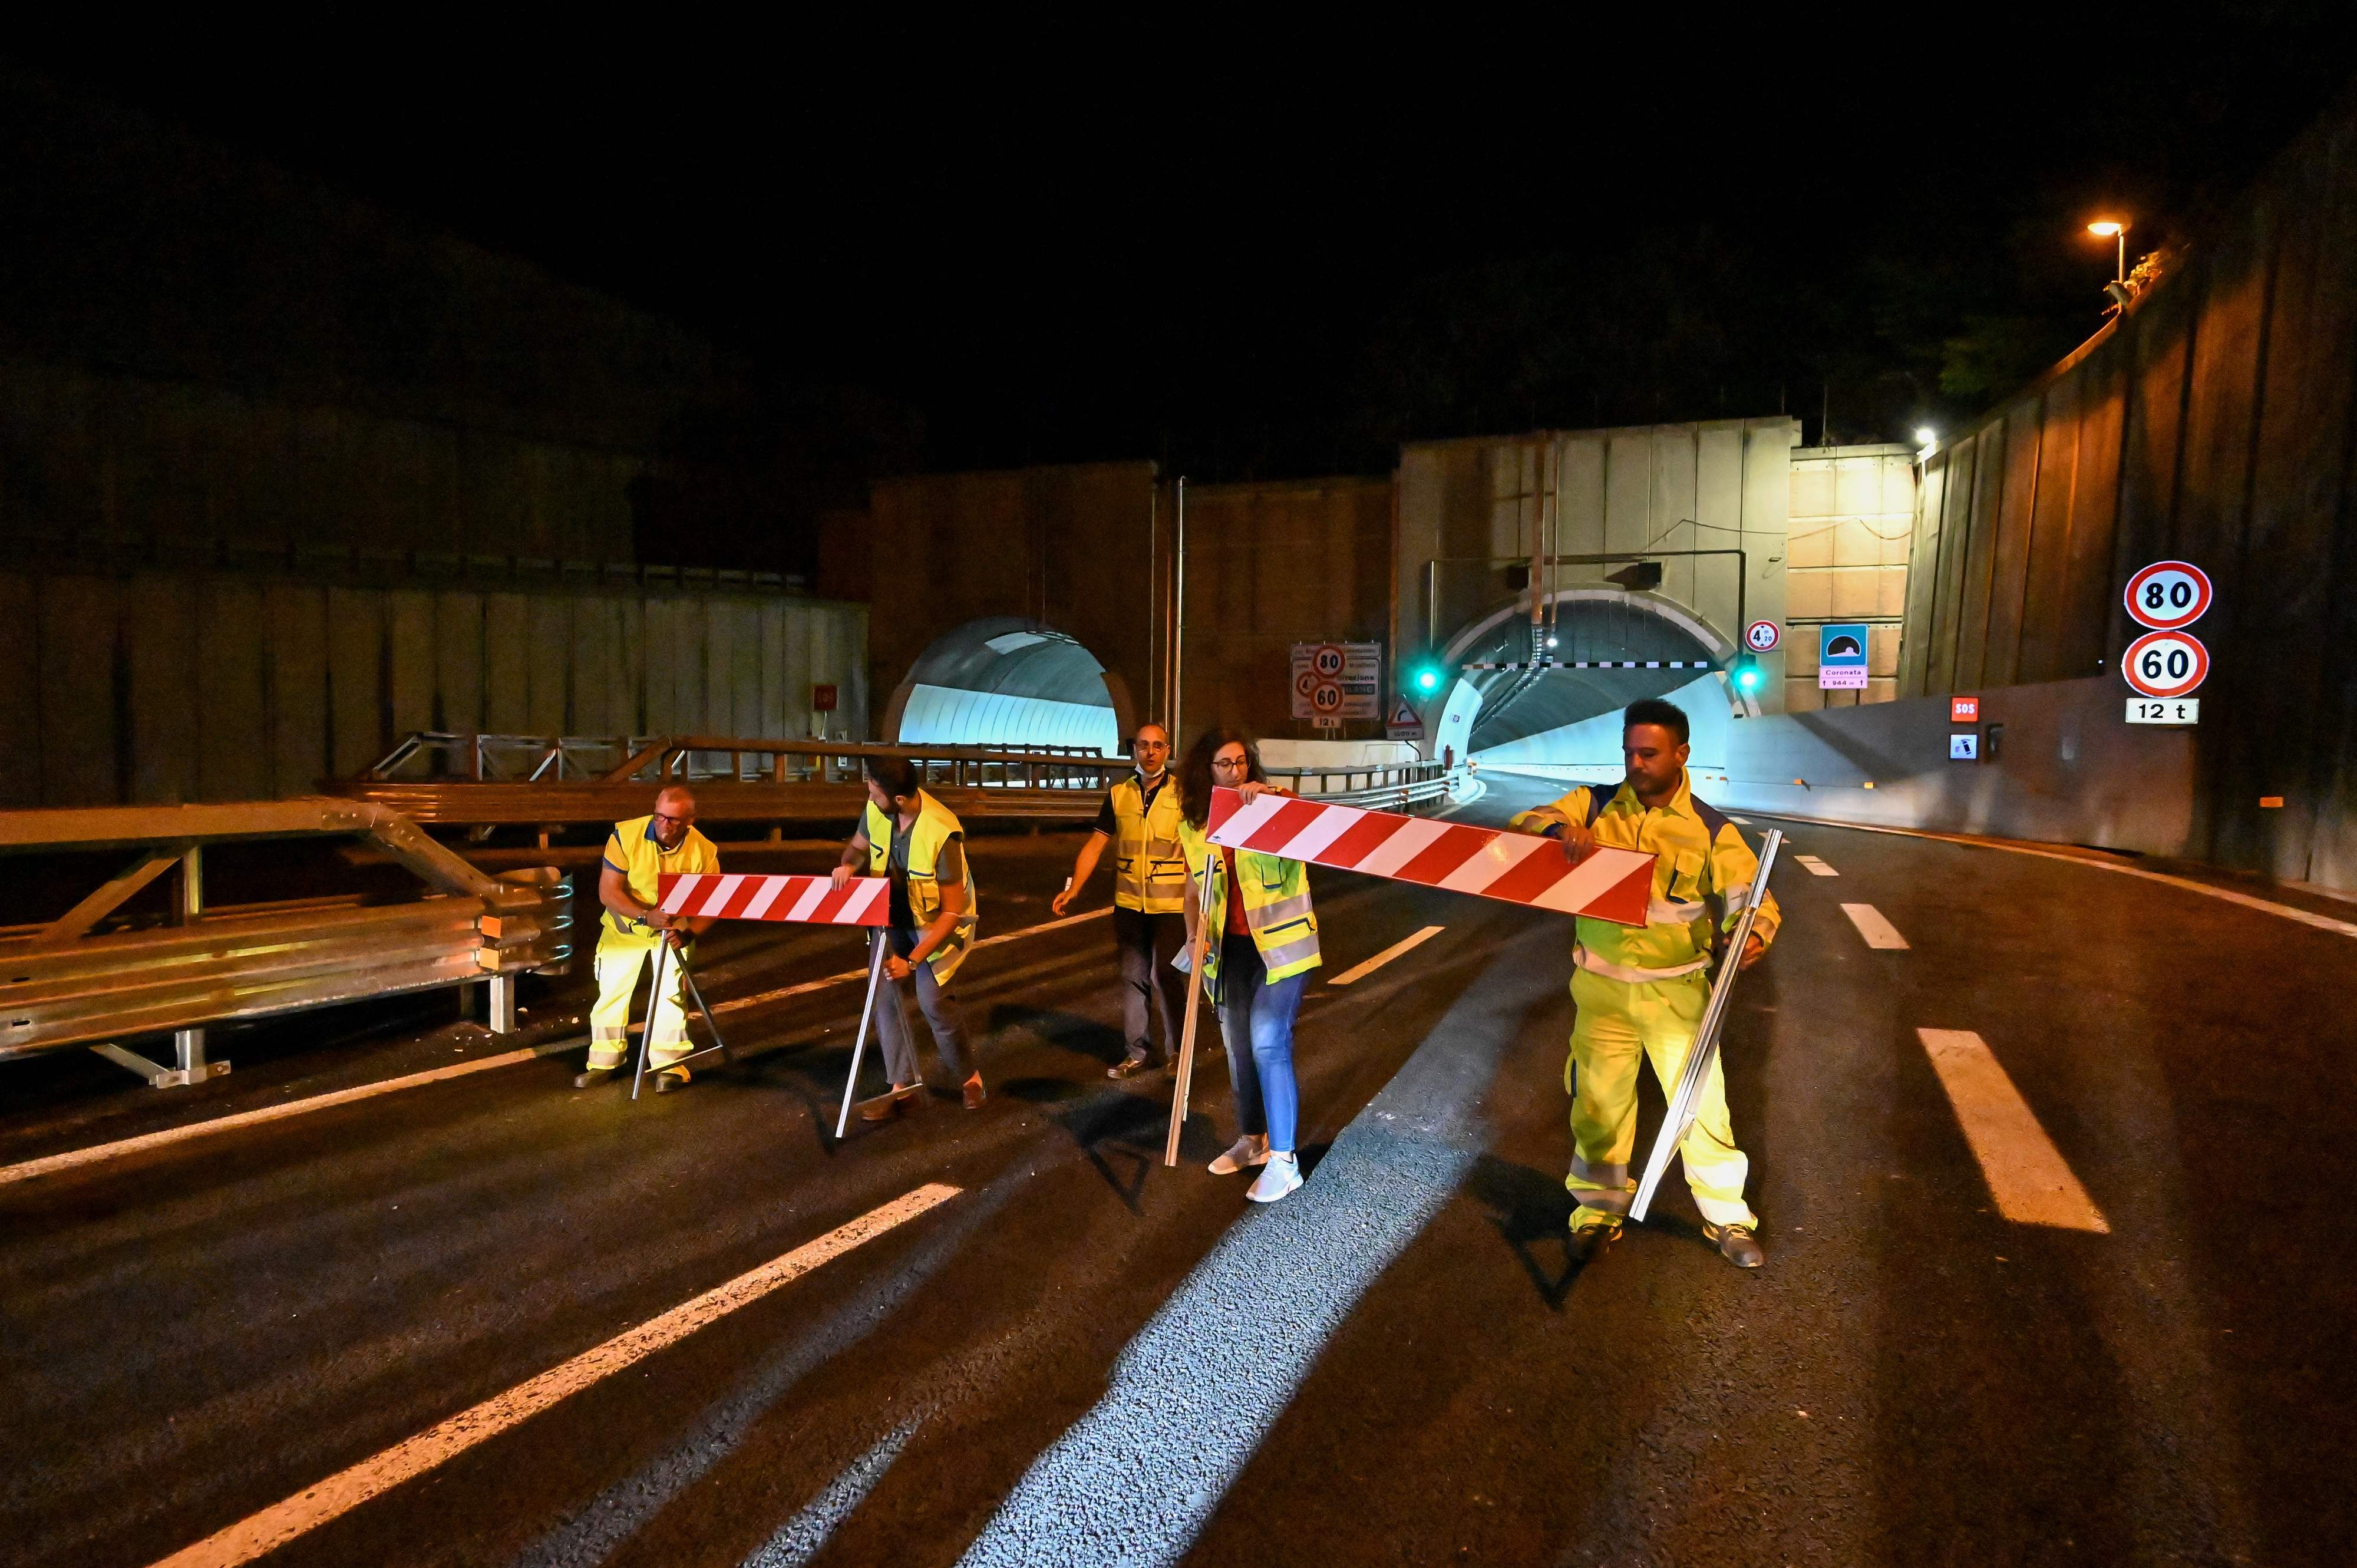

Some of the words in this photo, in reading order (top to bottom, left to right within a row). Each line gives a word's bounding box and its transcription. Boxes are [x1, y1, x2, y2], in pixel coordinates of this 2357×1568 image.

[2145, 581, 2191, 609] 80
[1753, 630, 1761, 642] 4
[1320, 655, 1339, 669] 80
[2142, 649, 2188, 679] 60
[1317, 689, 1336, 705] 60
[1955, 703, 1975, 714] SOS
[2138, 704, 2164, 719] 12
[2176, 704, 2186, 719] t
